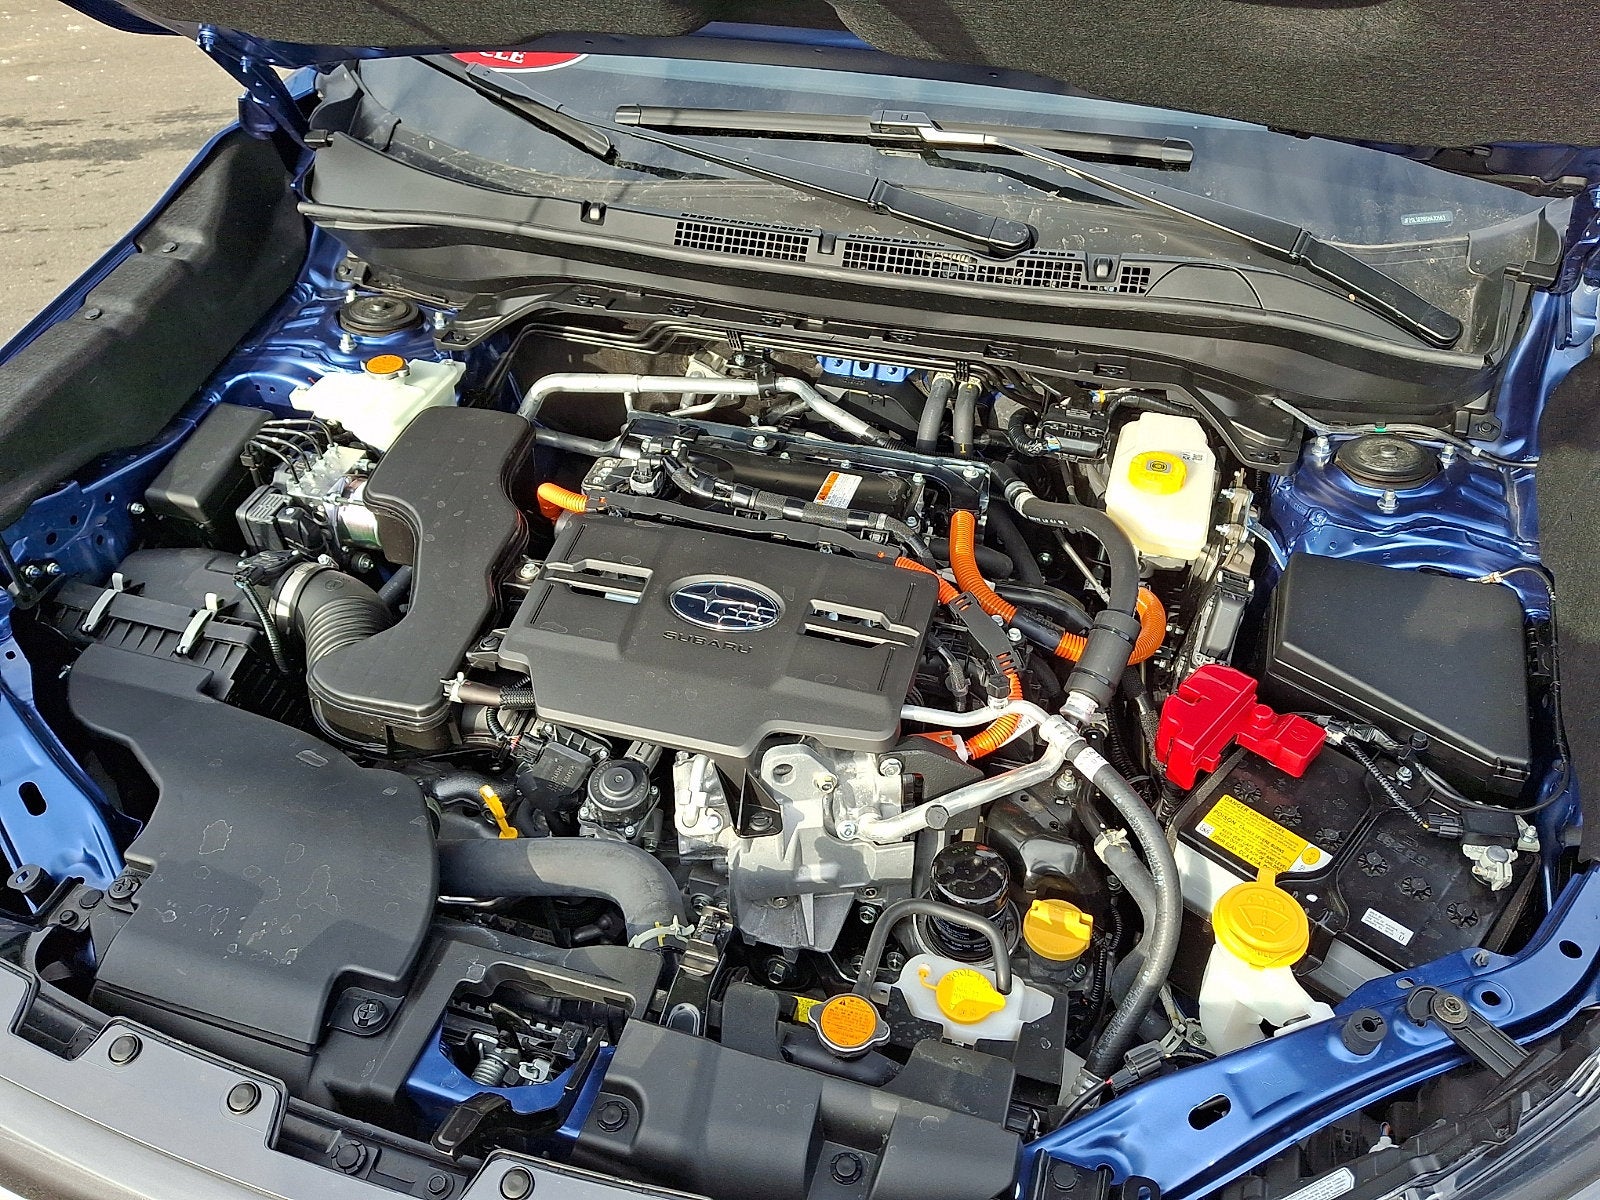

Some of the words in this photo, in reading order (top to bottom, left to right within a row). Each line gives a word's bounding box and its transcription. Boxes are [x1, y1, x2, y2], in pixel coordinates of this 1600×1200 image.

[662, 630, 753, 654] SUBARU
[1224, 795, 1249, 813] DANGER
[1212, 809, 1236, 825] POISON
